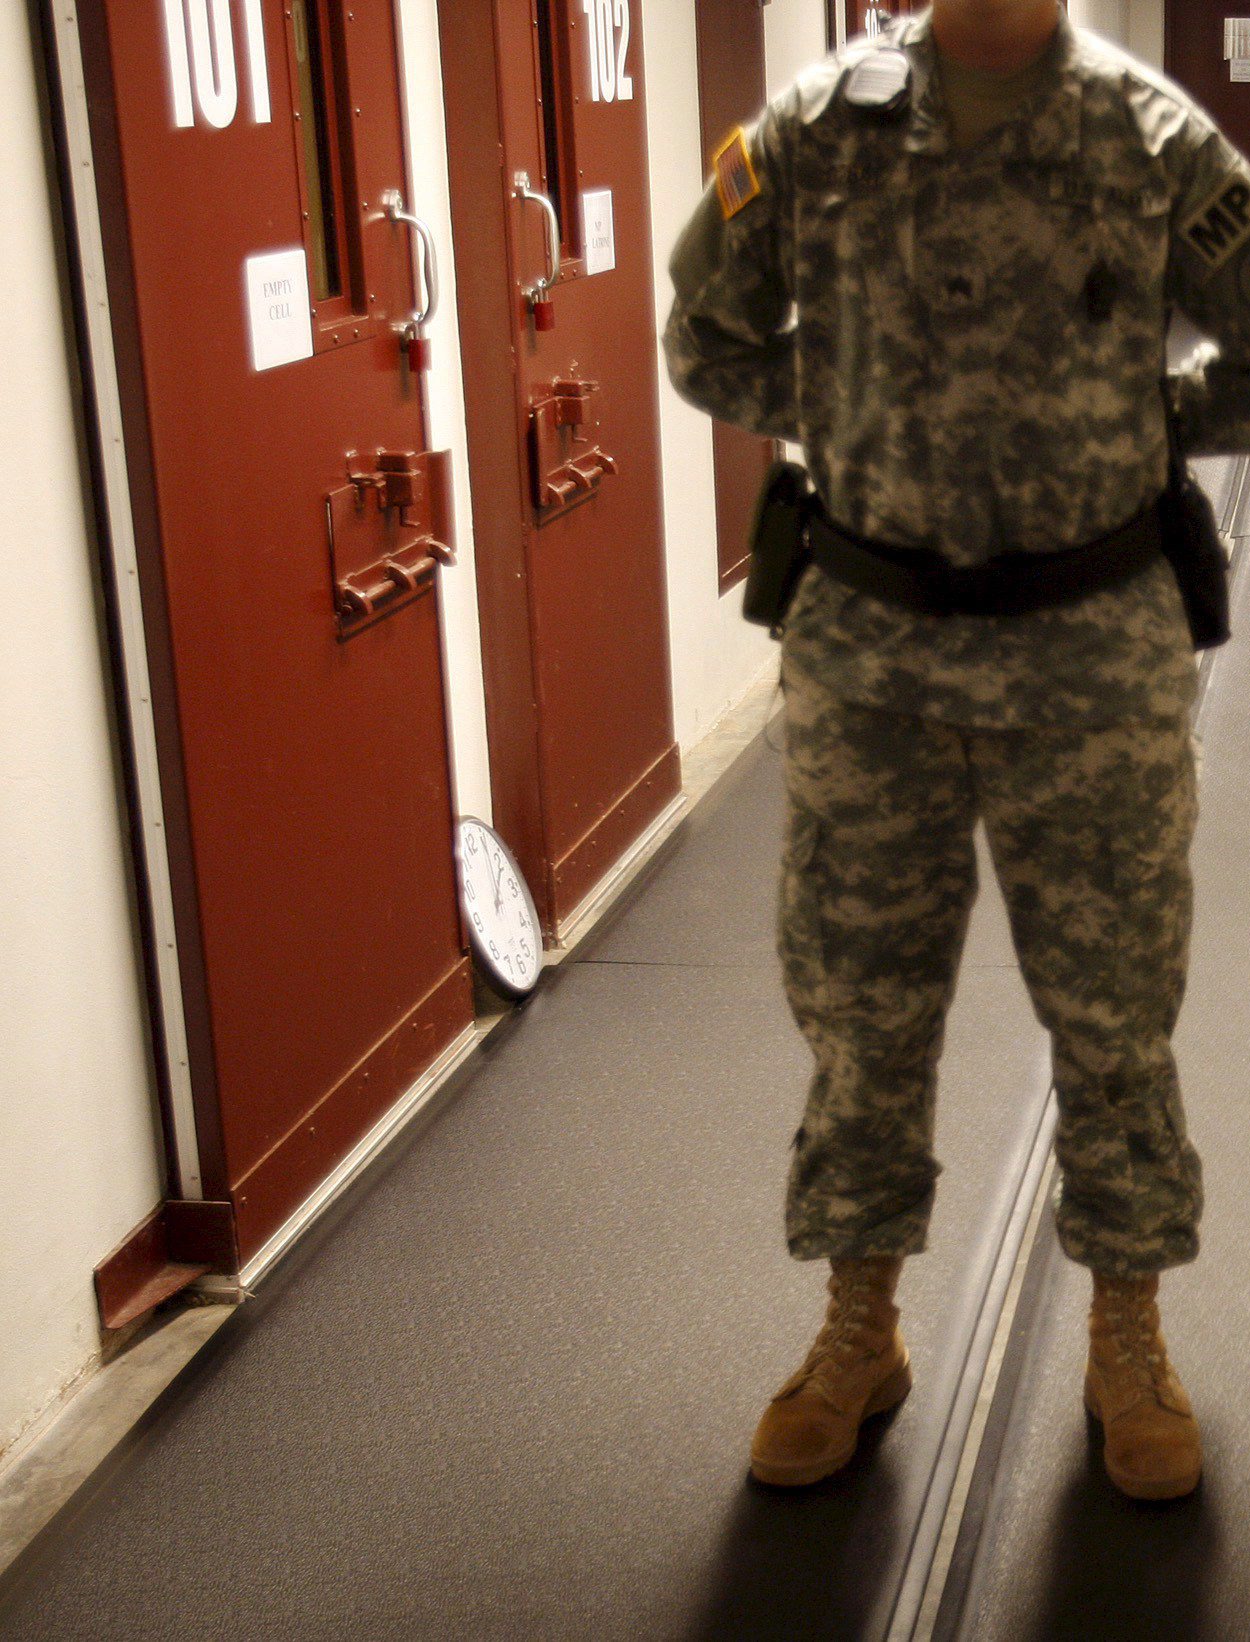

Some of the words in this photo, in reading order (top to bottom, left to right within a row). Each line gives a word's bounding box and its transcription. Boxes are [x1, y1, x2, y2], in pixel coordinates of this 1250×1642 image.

[583, 0, 634, 102] 102
[164, 0, 272, 128] 101
[1188, 182, 1250, 259] MP
[263, 279, 292, 298] EMPTY
[269, 304, 291, 321] CELL
[465, 833, 478, 855] 12
[494, 852, 504, 871] 2
[464, 879, 475, 902] 10
[507, 878, 518, 898] 3
[473, 912, 484, 933] 9
[489, 940, 500, 960] 8
[520, 938, 530, 957] 5
[516, 954, 526, 974] 6
